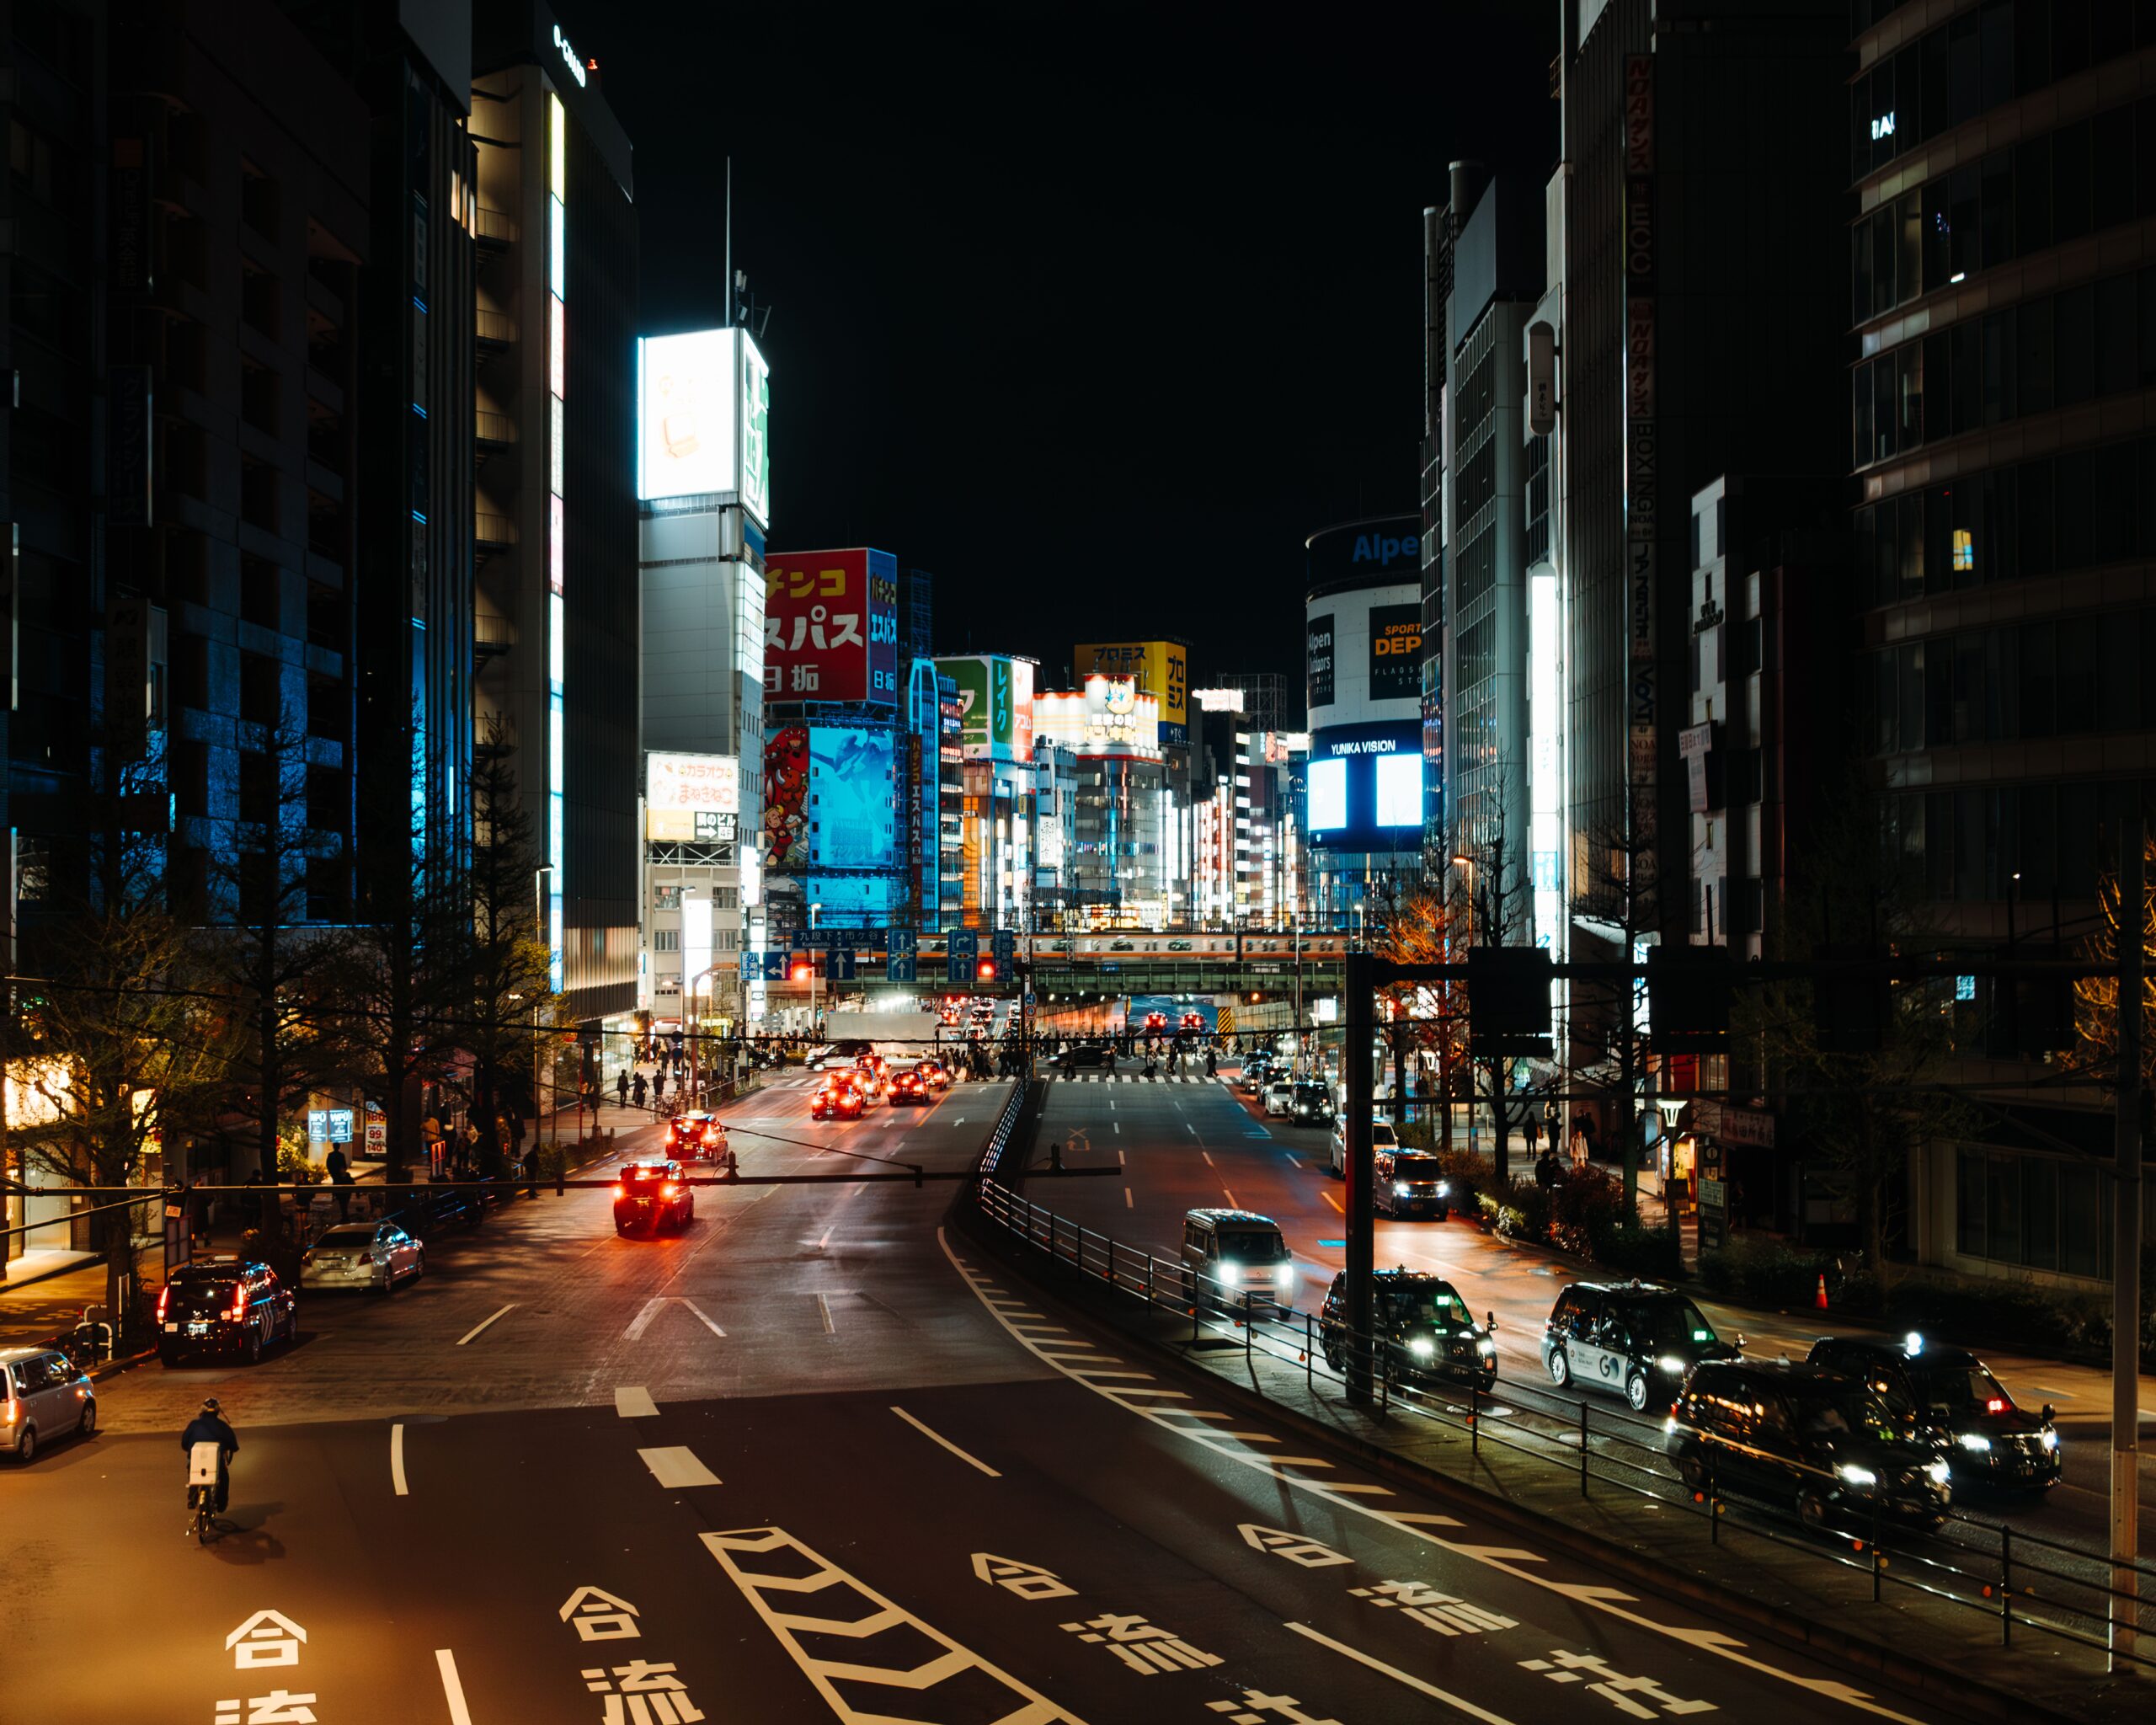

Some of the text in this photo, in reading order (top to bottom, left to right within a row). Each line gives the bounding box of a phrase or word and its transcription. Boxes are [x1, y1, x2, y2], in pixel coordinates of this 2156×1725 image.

[1630, 203, 1652, 275] ECC
[1636, 424, 1654, 512] BOXING
[1630, 515, 1655, 524] NOA
[1353, 533, 1419, 566] Alpe
[871, 609, 896, 645] エスパス
[1308, 632, 1331, 654] Alpen
[1374, 636, 1422, 656] DEP
[1094, 646, 1146, 661] プロミス
[997, 664, 1007, 731] レイク
[1331, 740, 1396, 756] YUNIKA VISION
[1630, 740, 1656, 750] NOA
[686, 764, 725, 778] カラオケ
[679, 782, 733, 804] まねきねこ
[799, 930, 834, 942] 九段下
[369, 1130, 382, 1139] 99
